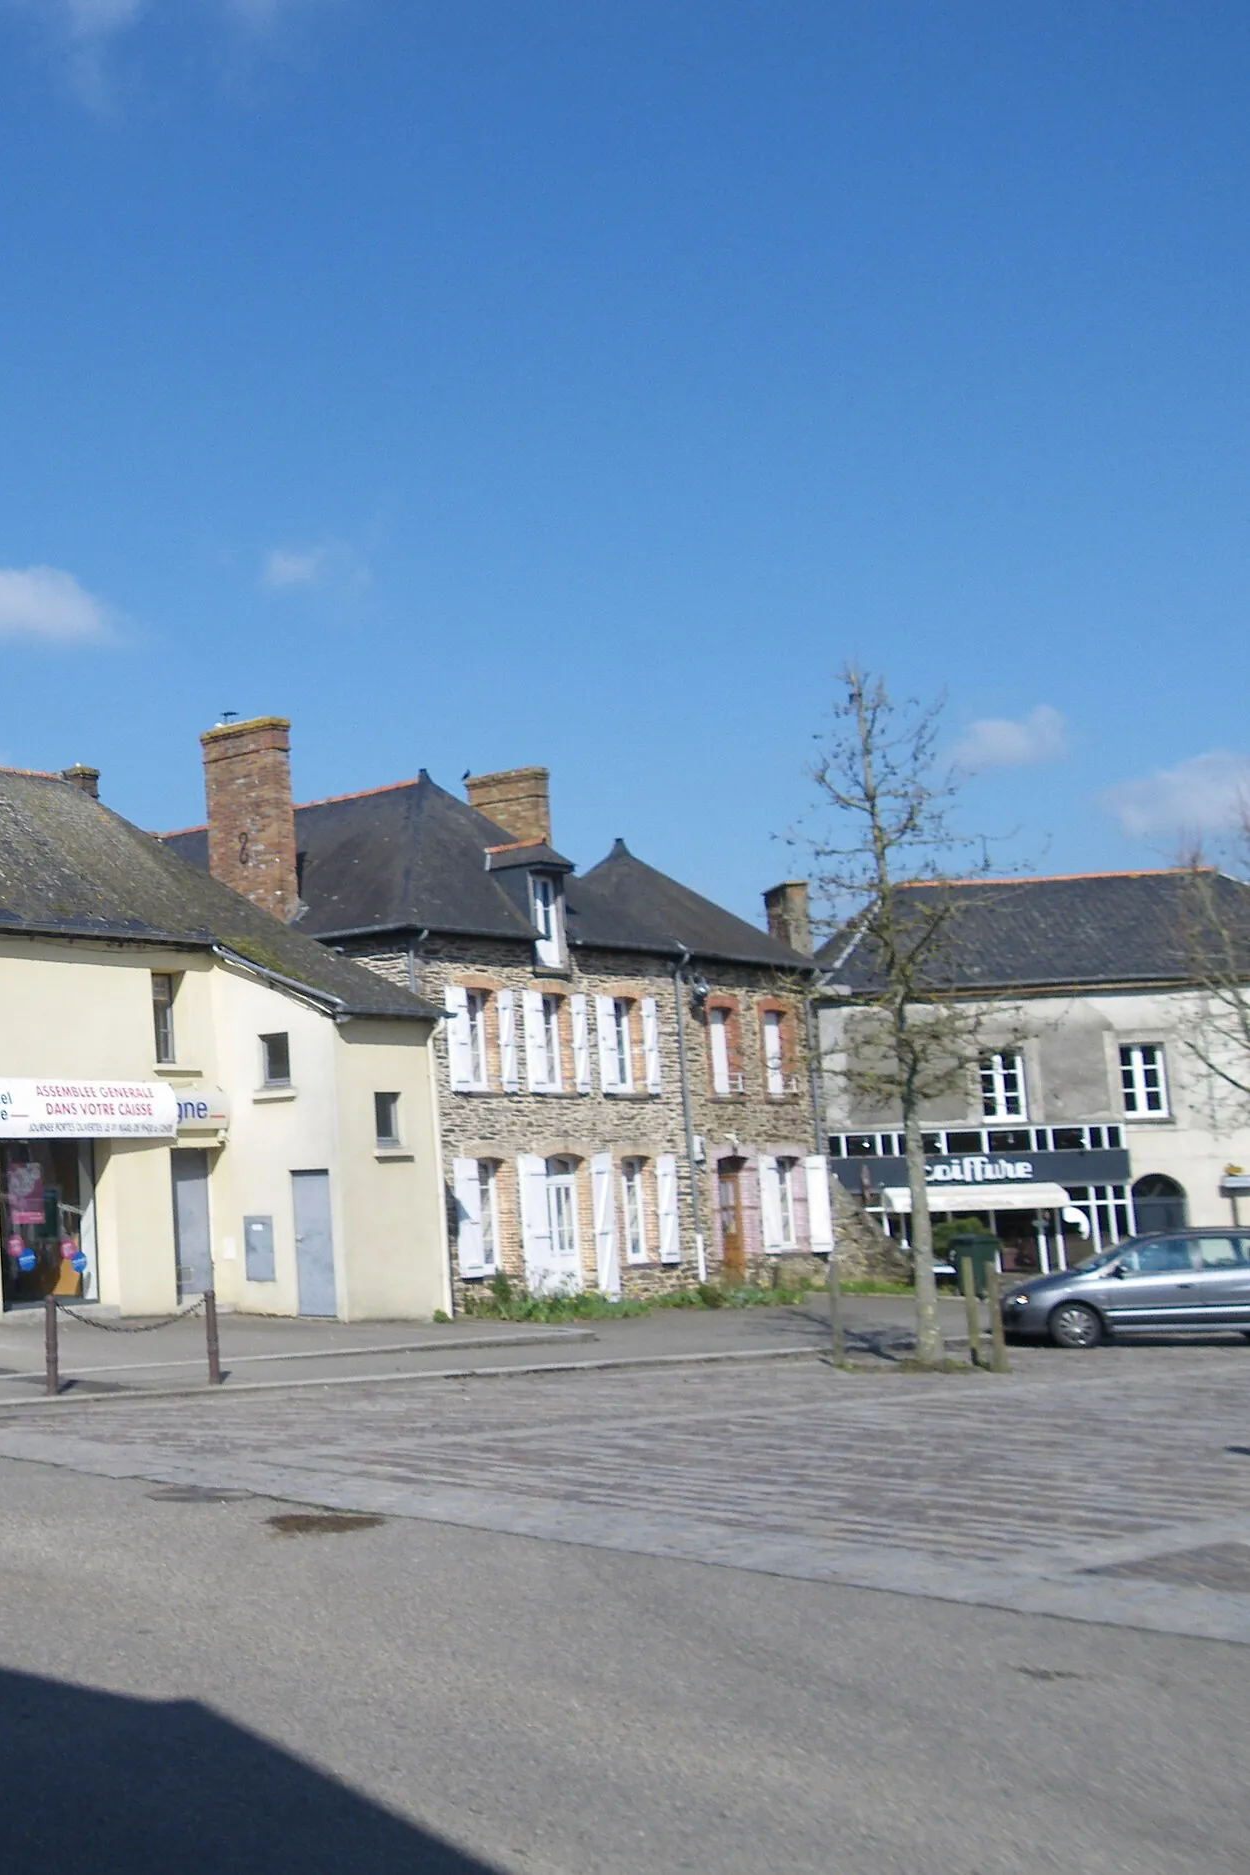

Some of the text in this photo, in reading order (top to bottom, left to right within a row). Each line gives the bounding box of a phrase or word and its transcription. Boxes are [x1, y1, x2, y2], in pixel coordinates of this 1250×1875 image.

[45, 1102, 154, 1116] DANS VOTRE CAISSE
